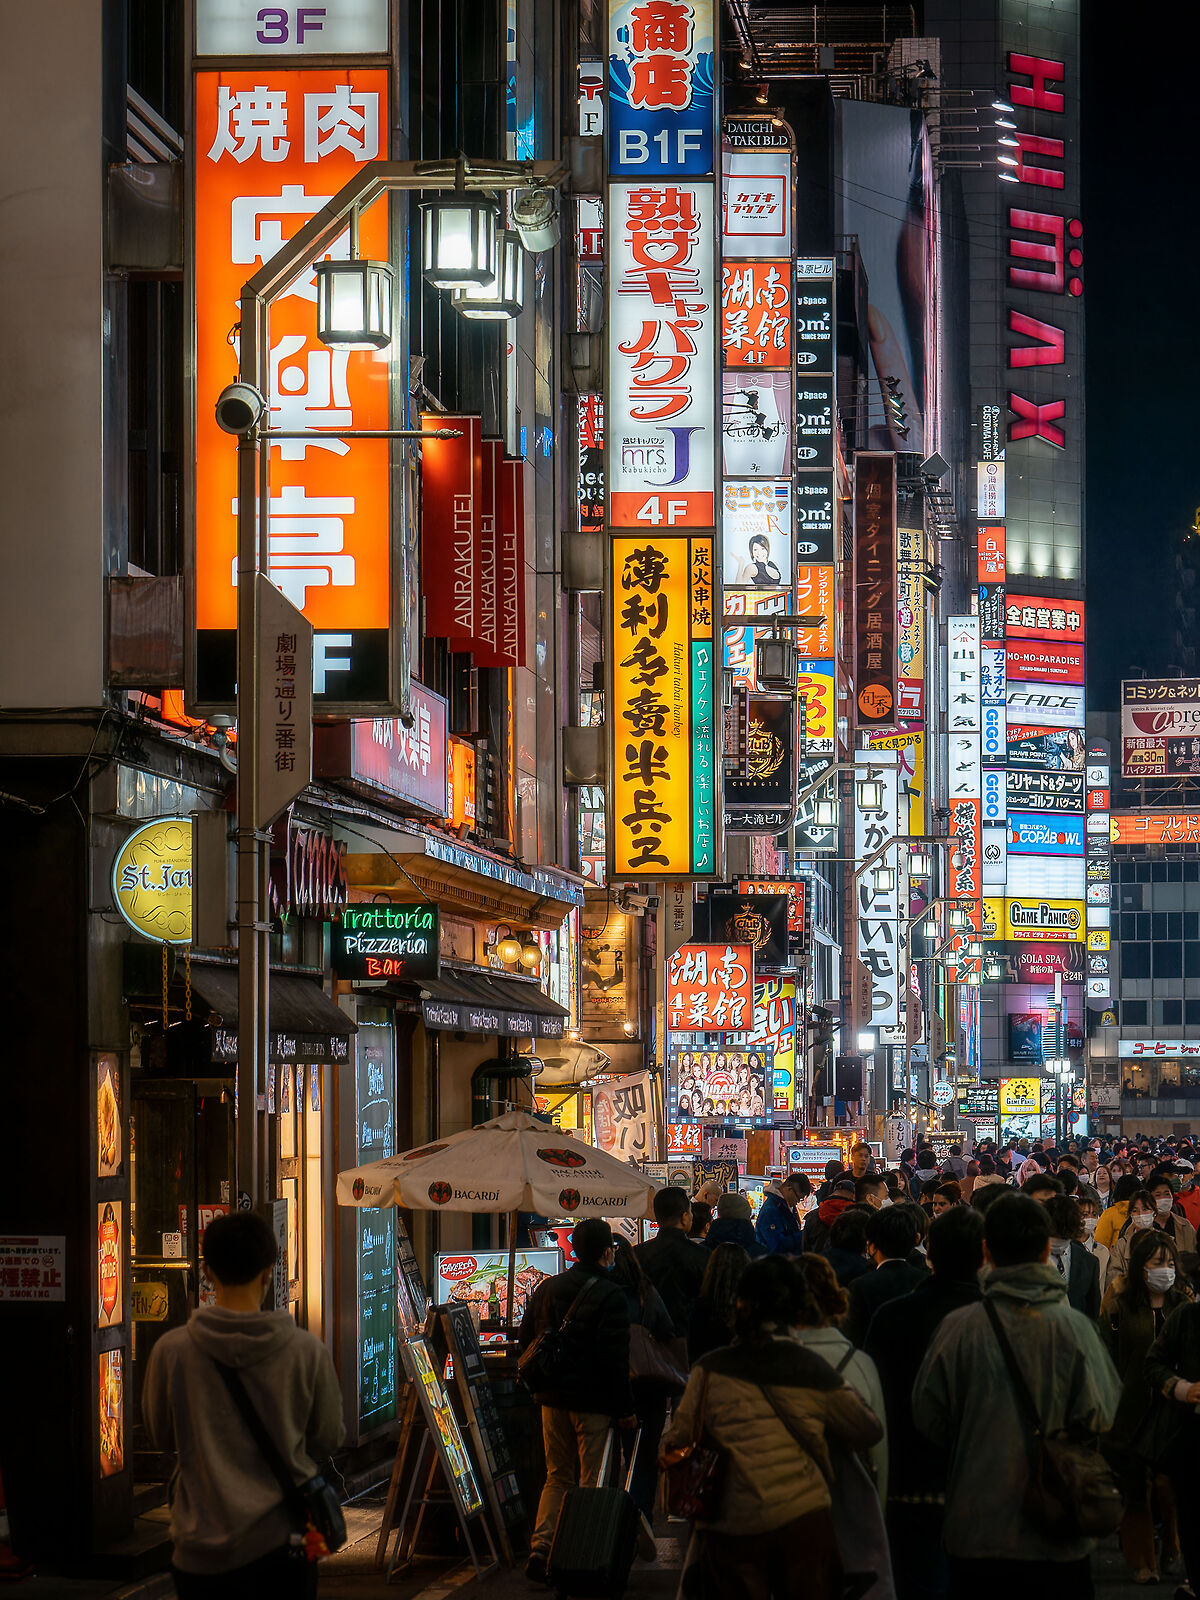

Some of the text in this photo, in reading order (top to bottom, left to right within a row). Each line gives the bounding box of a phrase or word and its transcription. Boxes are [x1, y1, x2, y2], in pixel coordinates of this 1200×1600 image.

[256, 8, 327, 44] 3F
[207, 85, 380, 163] 焼肉
[727, 122, 774, 133] DAIICHI
[619, 129, 703, 164] B1F
[731, 203, 780, 214] ラウンジ
[737, 192, 775, 202] カブキ
[617, 188, 710, 422] 熟女キャバクラ
[743, 351, 768, 364] 4F
[622, 466, 667, 474] Kabukicho
[637, 496, 687, 525] 4F
[453, 493, 473, 630] ANRAKUTEI
[480, 513, 495, 644] ANRAKUTEI
[691, 547, 711, 626] 炭火串焼
[502, 531, 517, 658] ANRAKUTEI
[1006, 605, 1081, 631] 全店営業中
[1007, 653, 1080, 665] MO-MO-PARADISE
[981, 665, 992, 698] の鉄人
[993, 650, 1005, 698] カラオケ
[274, 632, 298, 772] 劇場通り一番街
[985, 708, 999, 753] GiGO
[1126, 738, 1166, 748] 新宿最大
[1126, 764, 1166, 774] ハイジアB1
[985, 773, 999, 817] GiGO
[1029, 795, 1054, 808] ゴルフ
[342, 908, 434, 930] Trattoria
[344, 932, 428, 955] Pizzeria
[365, 957, 403, 976] Bar
[1021, 953, 1062, 965] SOLA SPA
[686, 991, 748, 1028] 菜館
[1133, 1042, 1177, 1054] コーヒー
[454, 1189, 500, 1201] BACARDÍ
[582, 1194, 628, 1207] BACARDÍ
[101, 1262, 117, 1279] PRIDE
